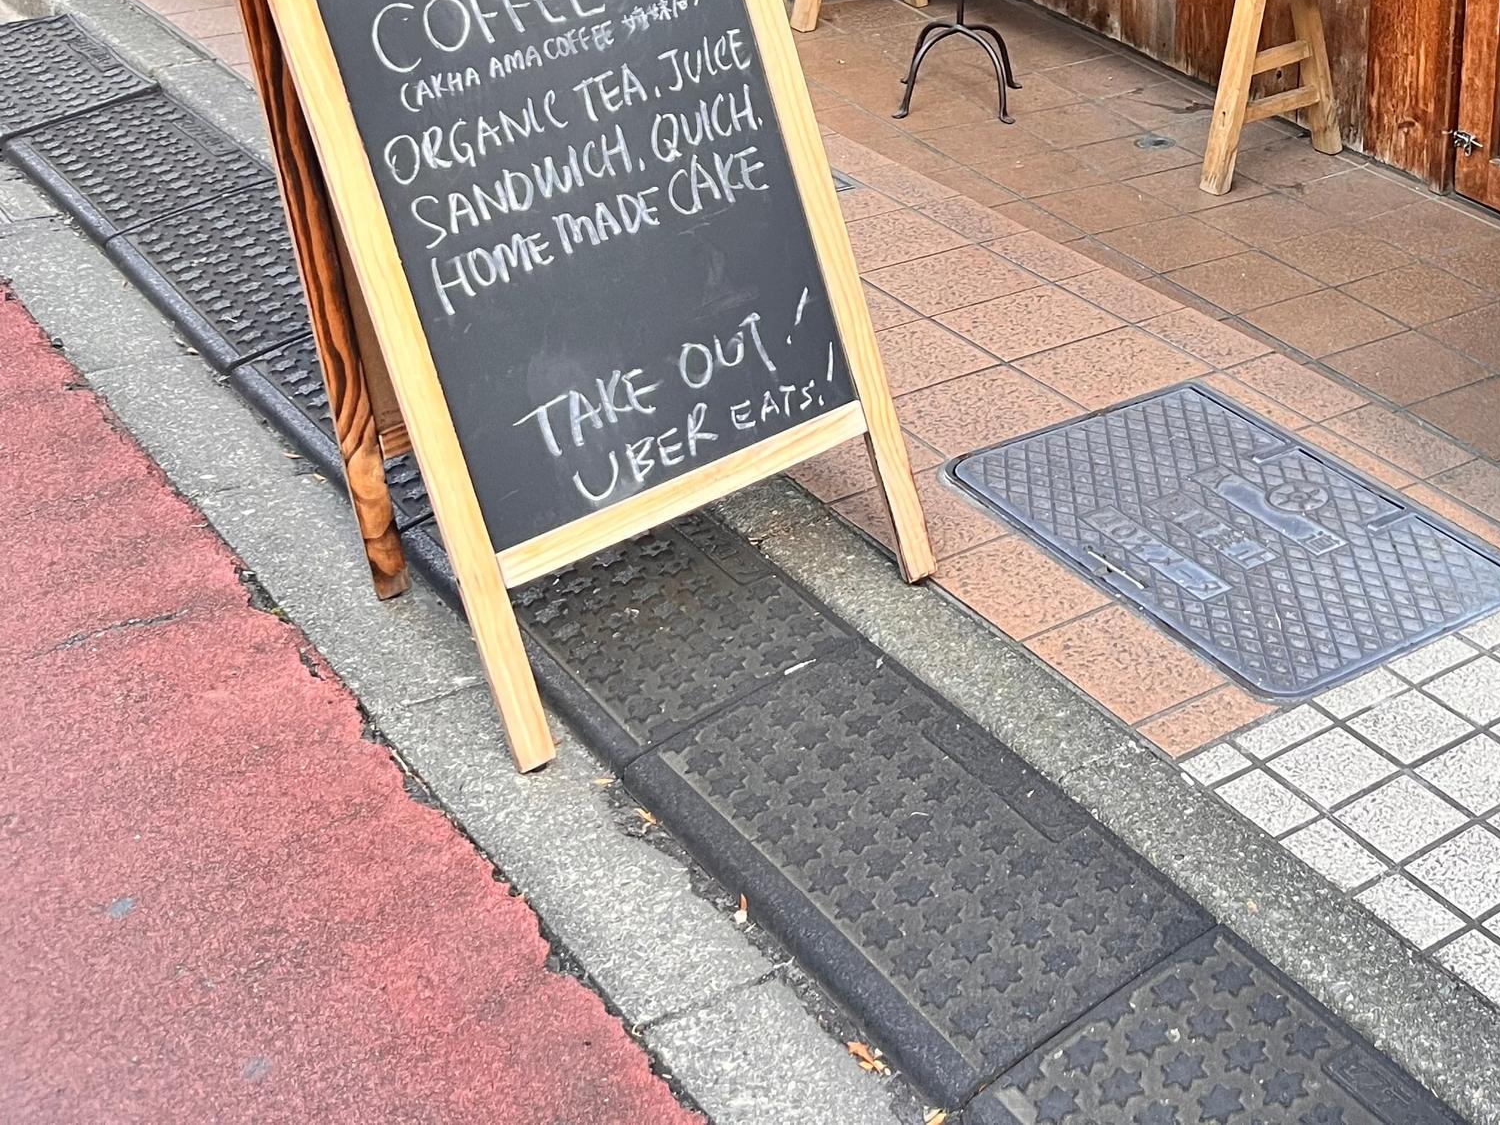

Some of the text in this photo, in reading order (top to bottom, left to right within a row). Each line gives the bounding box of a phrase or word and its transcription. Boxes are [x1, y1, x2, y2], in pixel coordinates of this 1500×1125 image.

[489, 47, 544, 78] AMA
[543, 20, 616, 61] COFFEE
[383, 89, 569, 186] ORGANIC
[657, 27, 752, 93] JUICE
[430, 146, 770, 316] HOME MADE CAKE
[511, 367, 662, 457] TAKE
[572, 402, 718, 502] UBER
